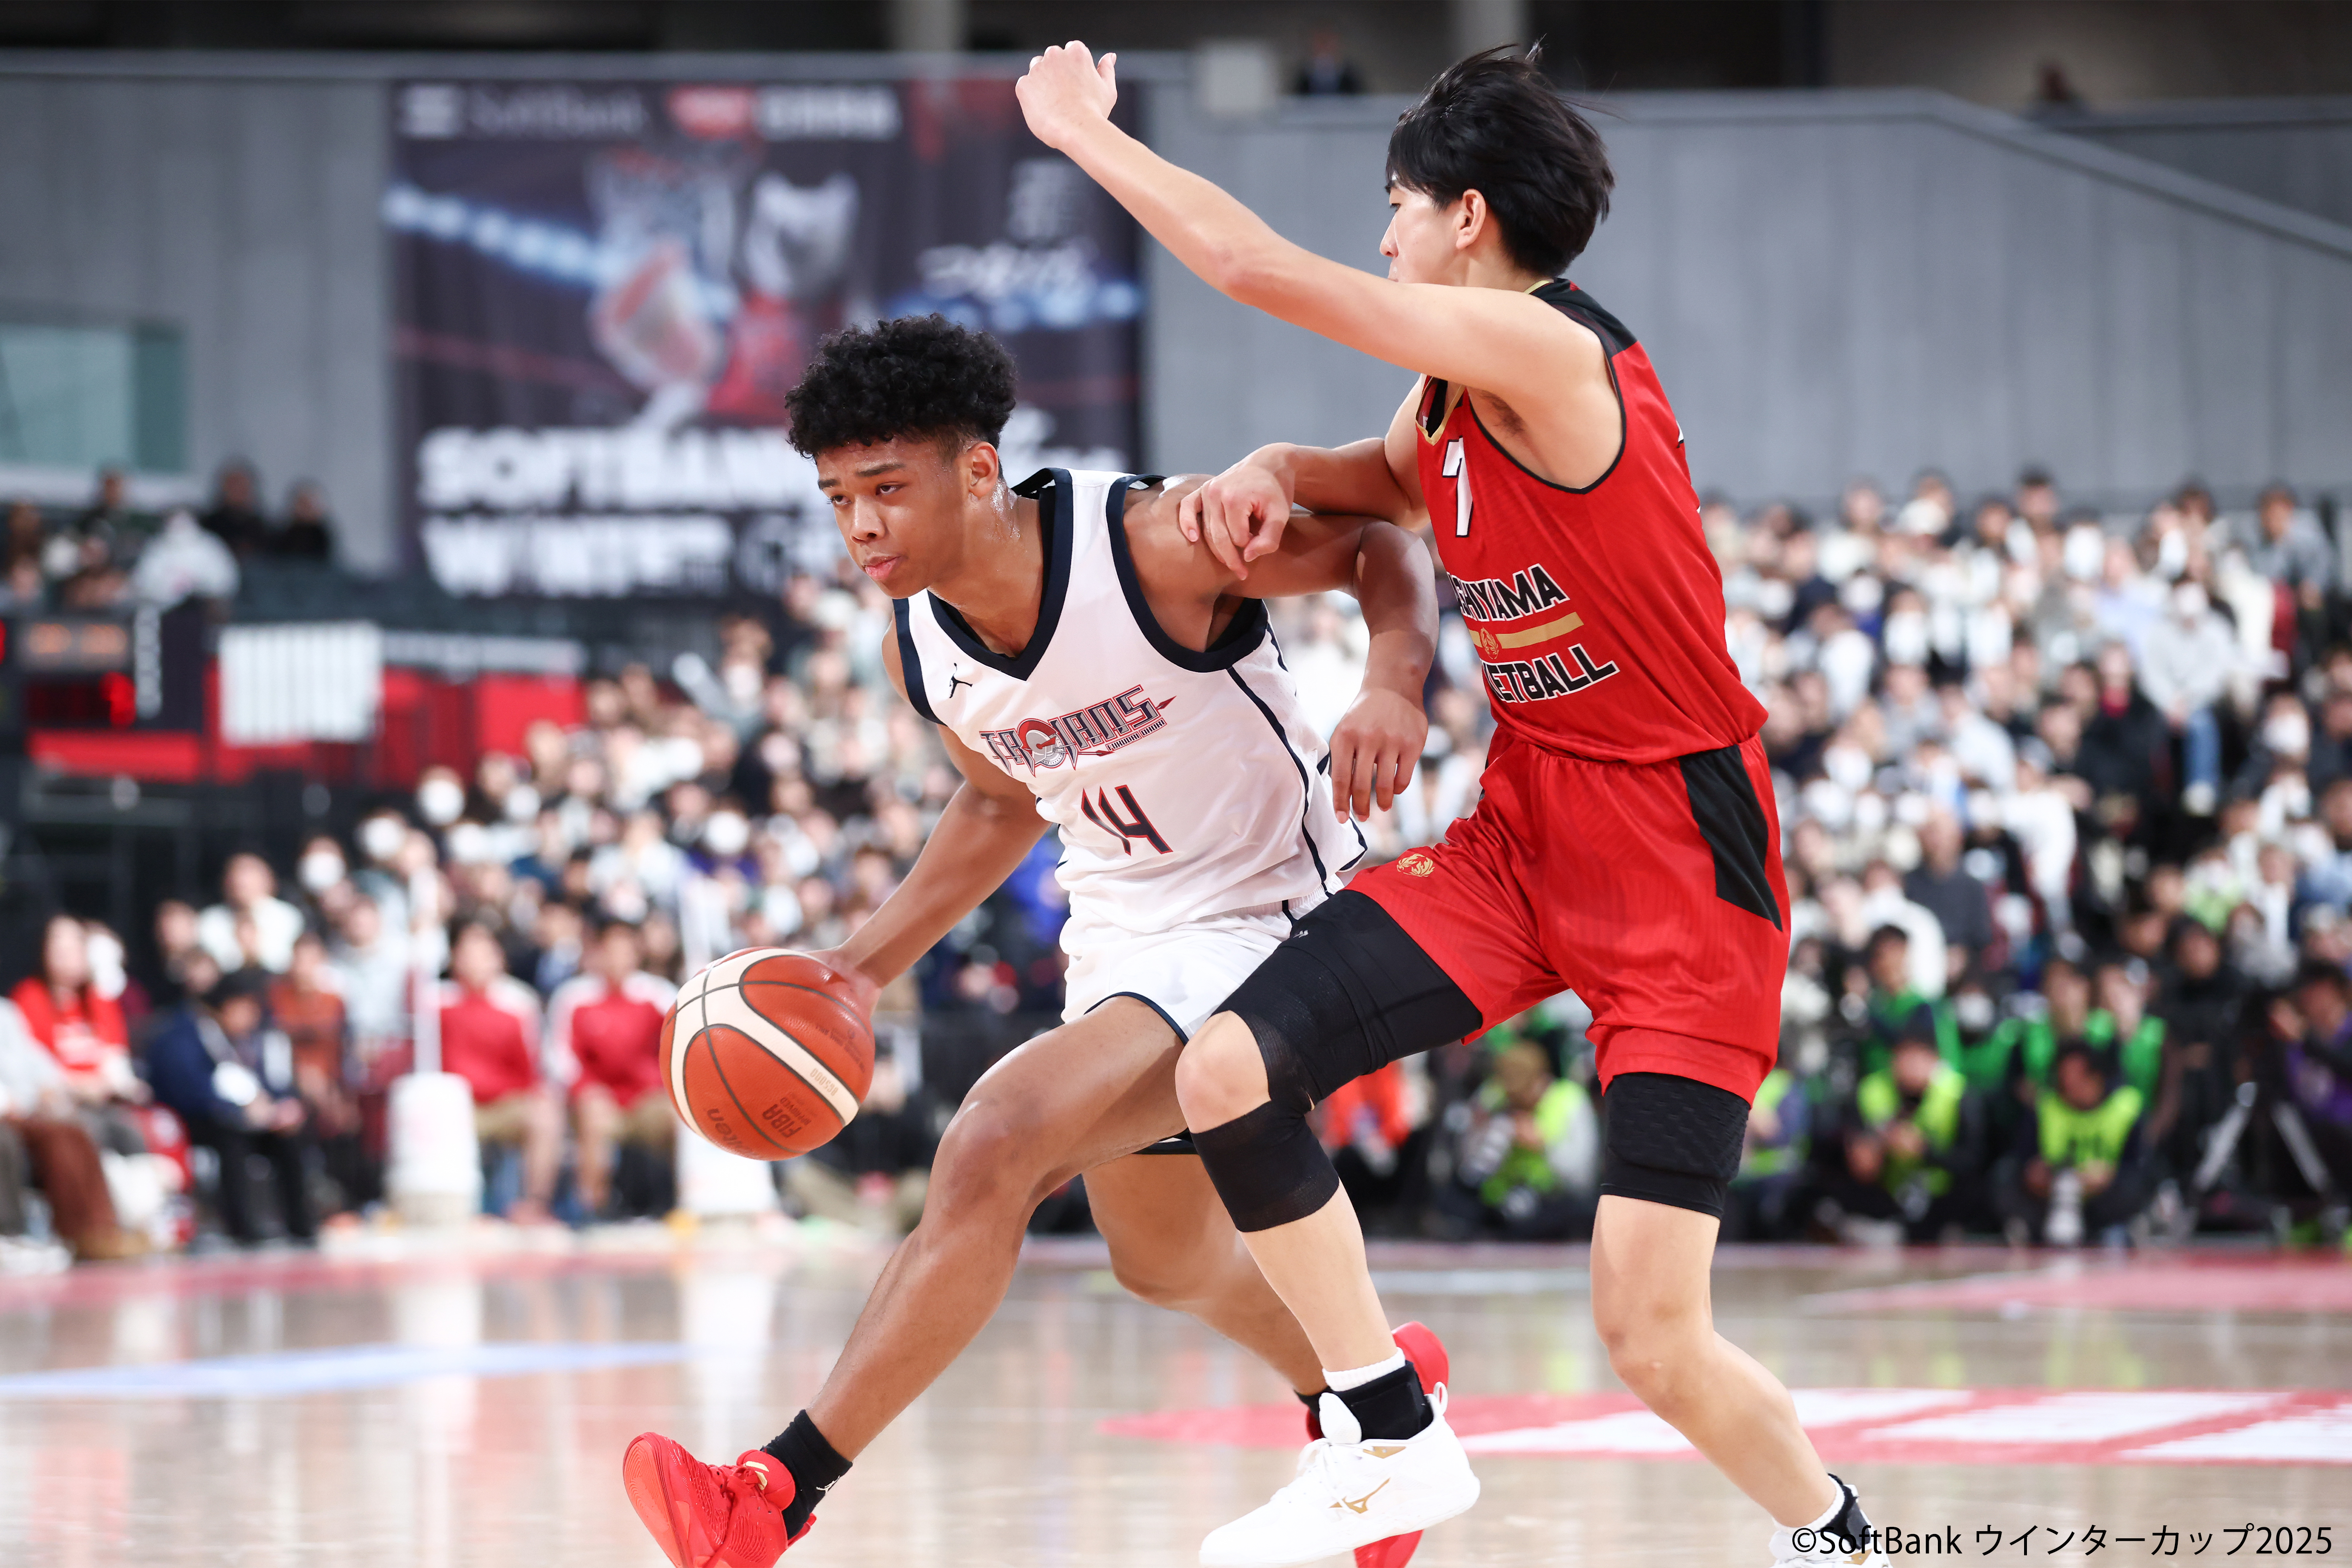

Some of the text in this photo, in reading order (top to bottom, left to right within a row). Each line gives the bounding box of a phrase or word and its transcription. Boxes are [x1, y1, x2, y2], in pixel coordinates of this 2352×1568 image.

[1446, 563, 1570, 621] SHIYAMA
[1480, 644, 1621, 703] ETBALL
[979, 684, 1162, 777] TROJANS
[1081, 784, 1174, 857] 14
[762, 1104, 802, 1138] FIBA
